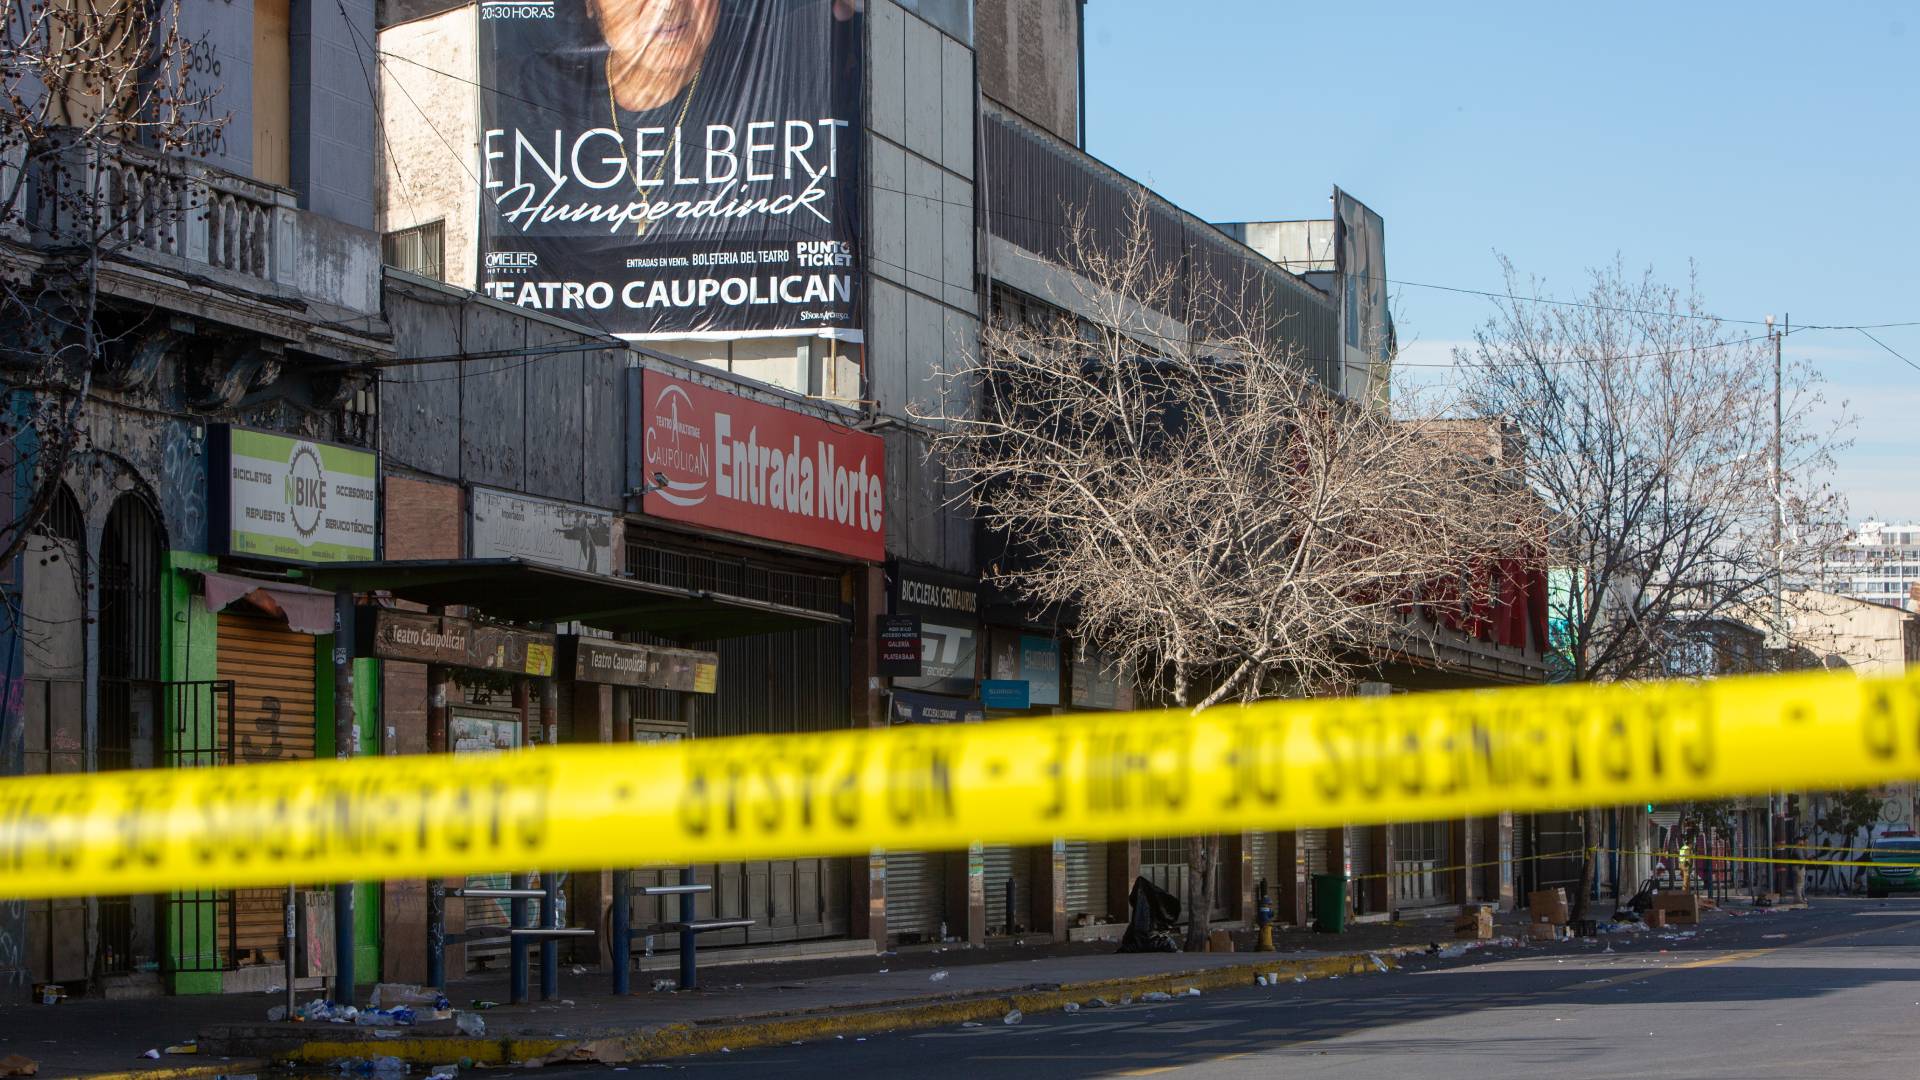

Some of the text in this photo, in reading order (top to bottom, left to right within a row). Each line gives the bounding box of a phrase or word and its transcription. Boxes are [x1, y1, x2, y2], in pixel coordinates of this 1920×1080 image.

[482, 6, 556, 20] 20:30 HORAS
[484, 118, 849, 189] ENGELBERT
[495, 165, 831, 233] Humperdinck
[626, 258, 658, 269] ENTRADAS
[659, 258, 668, 267] EN
[740, 250, 757, 264] DEL
[758, 249, 789, 263] TEATRO
[796, 241, 851, 255] PUNTO
[796, 254, 853, 267] TICKET
[484, 274, 851, 310] TEATRO CAUPOLICAN
[646, 426, 709, 478] CAUPOLICAN
[232, 467, 272, 485] BICICLETAS
[714, 412, 883, 533] Entrada Norte
[284, 474, 327, 510] NBIKE
[336, 485, 374, 501] ACCESORIOS
[245, 507, 285, 523] REPUESTOS
[325, 518, 374, 535] SERVICIO TÉCNICO
[901, 579, 977, 614] BICICLETAS CENTAURUS
[392, 624, 465, 652] Teatro Caupolicán
[591, 650, 647, 675] Teatro Caupolicán
